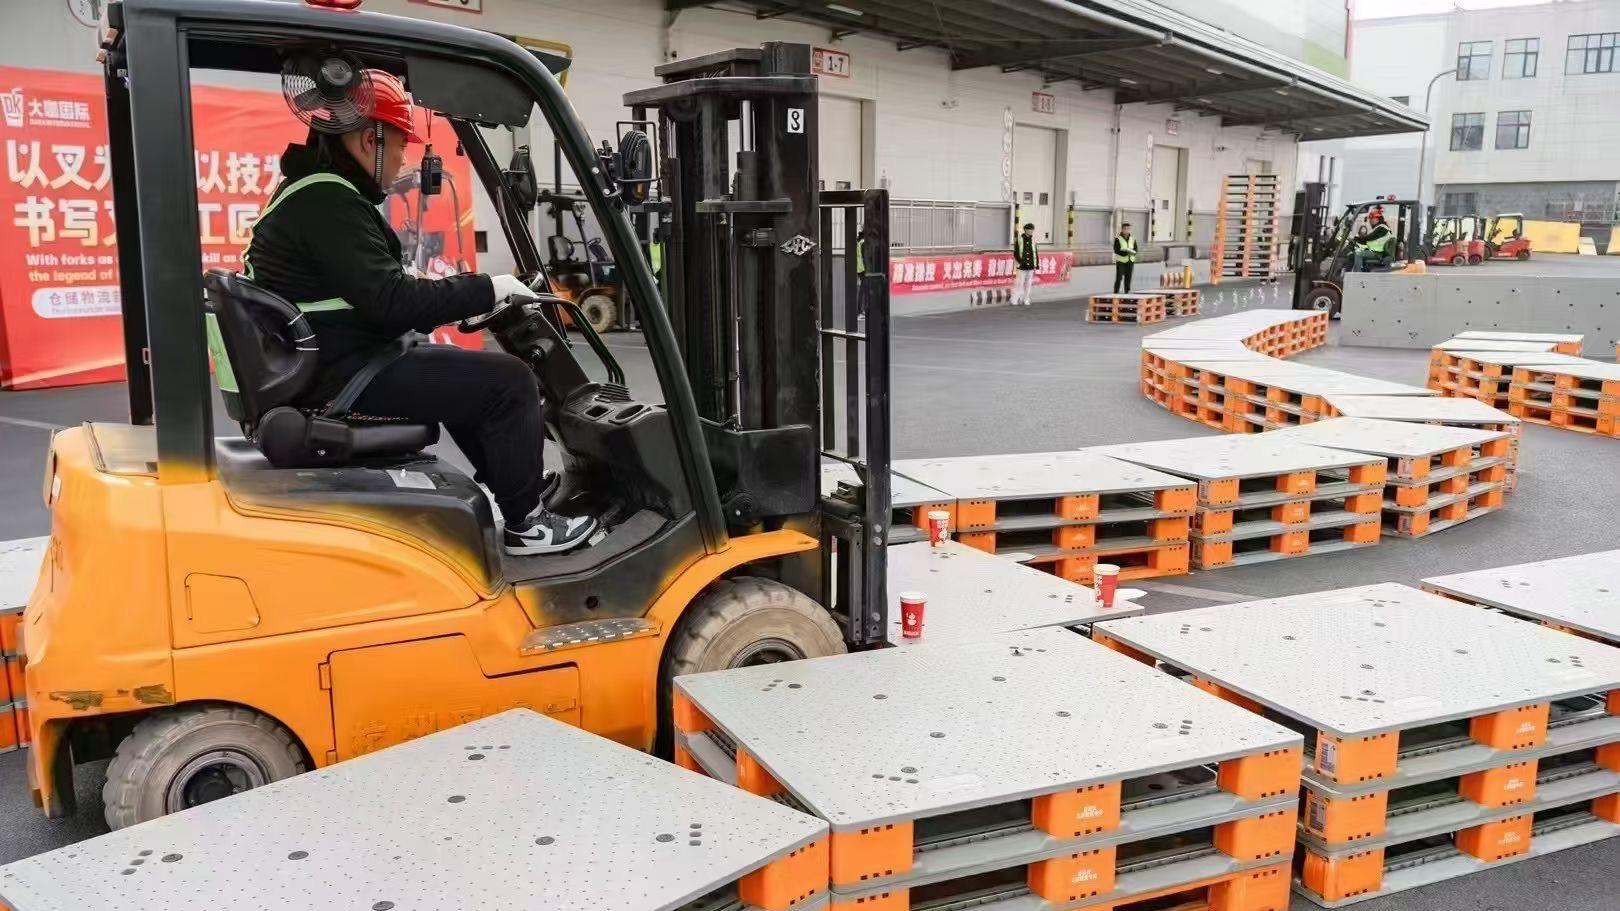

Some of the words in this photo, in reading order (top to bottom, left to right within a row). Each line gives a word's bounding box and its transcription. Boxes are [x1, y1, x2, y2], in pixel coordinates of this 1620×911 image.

[26, 253, 59, 266] With
[61, 253, 95, 266] forks
[97, 255, 113, 265] as
[202, 252, 220, 263] kill
[28, 270, 50, 282] the
[53, 269, 97, 284] legend
[99, 269, 113, 281] of
